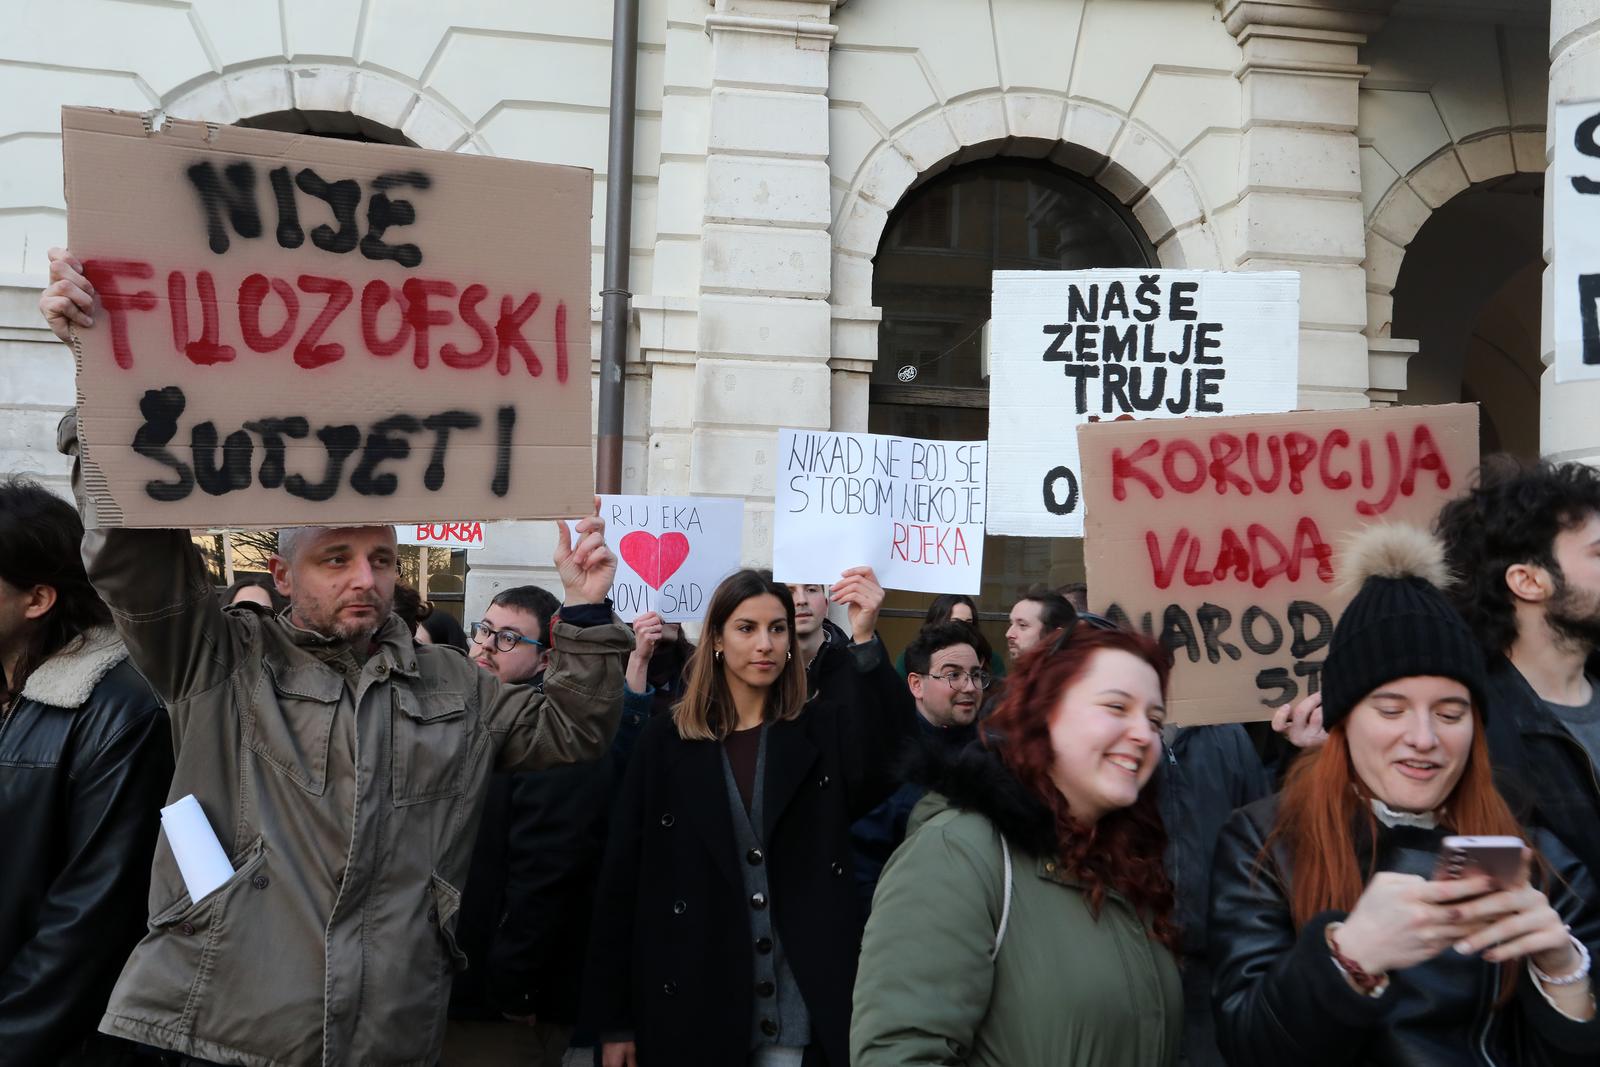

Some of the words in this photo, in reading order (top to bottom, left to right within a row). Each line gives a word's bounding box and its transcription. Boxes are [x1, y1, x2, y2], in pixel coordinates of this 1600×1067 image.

[187, 160, 431, 267] NIJE
[83, 259, 568, 383] FILOZOFSKI
[1068, 274, 1199, 322] NAŠE
[1043, 322, 1224, 365] ZEMLJE
[1064, 363, 1225, 415] TRUJE
[788, 434, 863, 474] NIKAD
[872, 439, 902, 477] NE
[911, 442, 947, 482] BOJ
[955, 445, 982, 482] SE
[1112, 424, 1451, 516] KORUPCIJA
[1043, 466, 1079, 515] O
[416, 521, 483, 543] BORBA
[891, 523, 970, 566] RIJEKA
[1145, 516, 1334, 589] VLADA
[661, 582, 703, 614] SAD
[1255, 661, 1323, 709] ST
